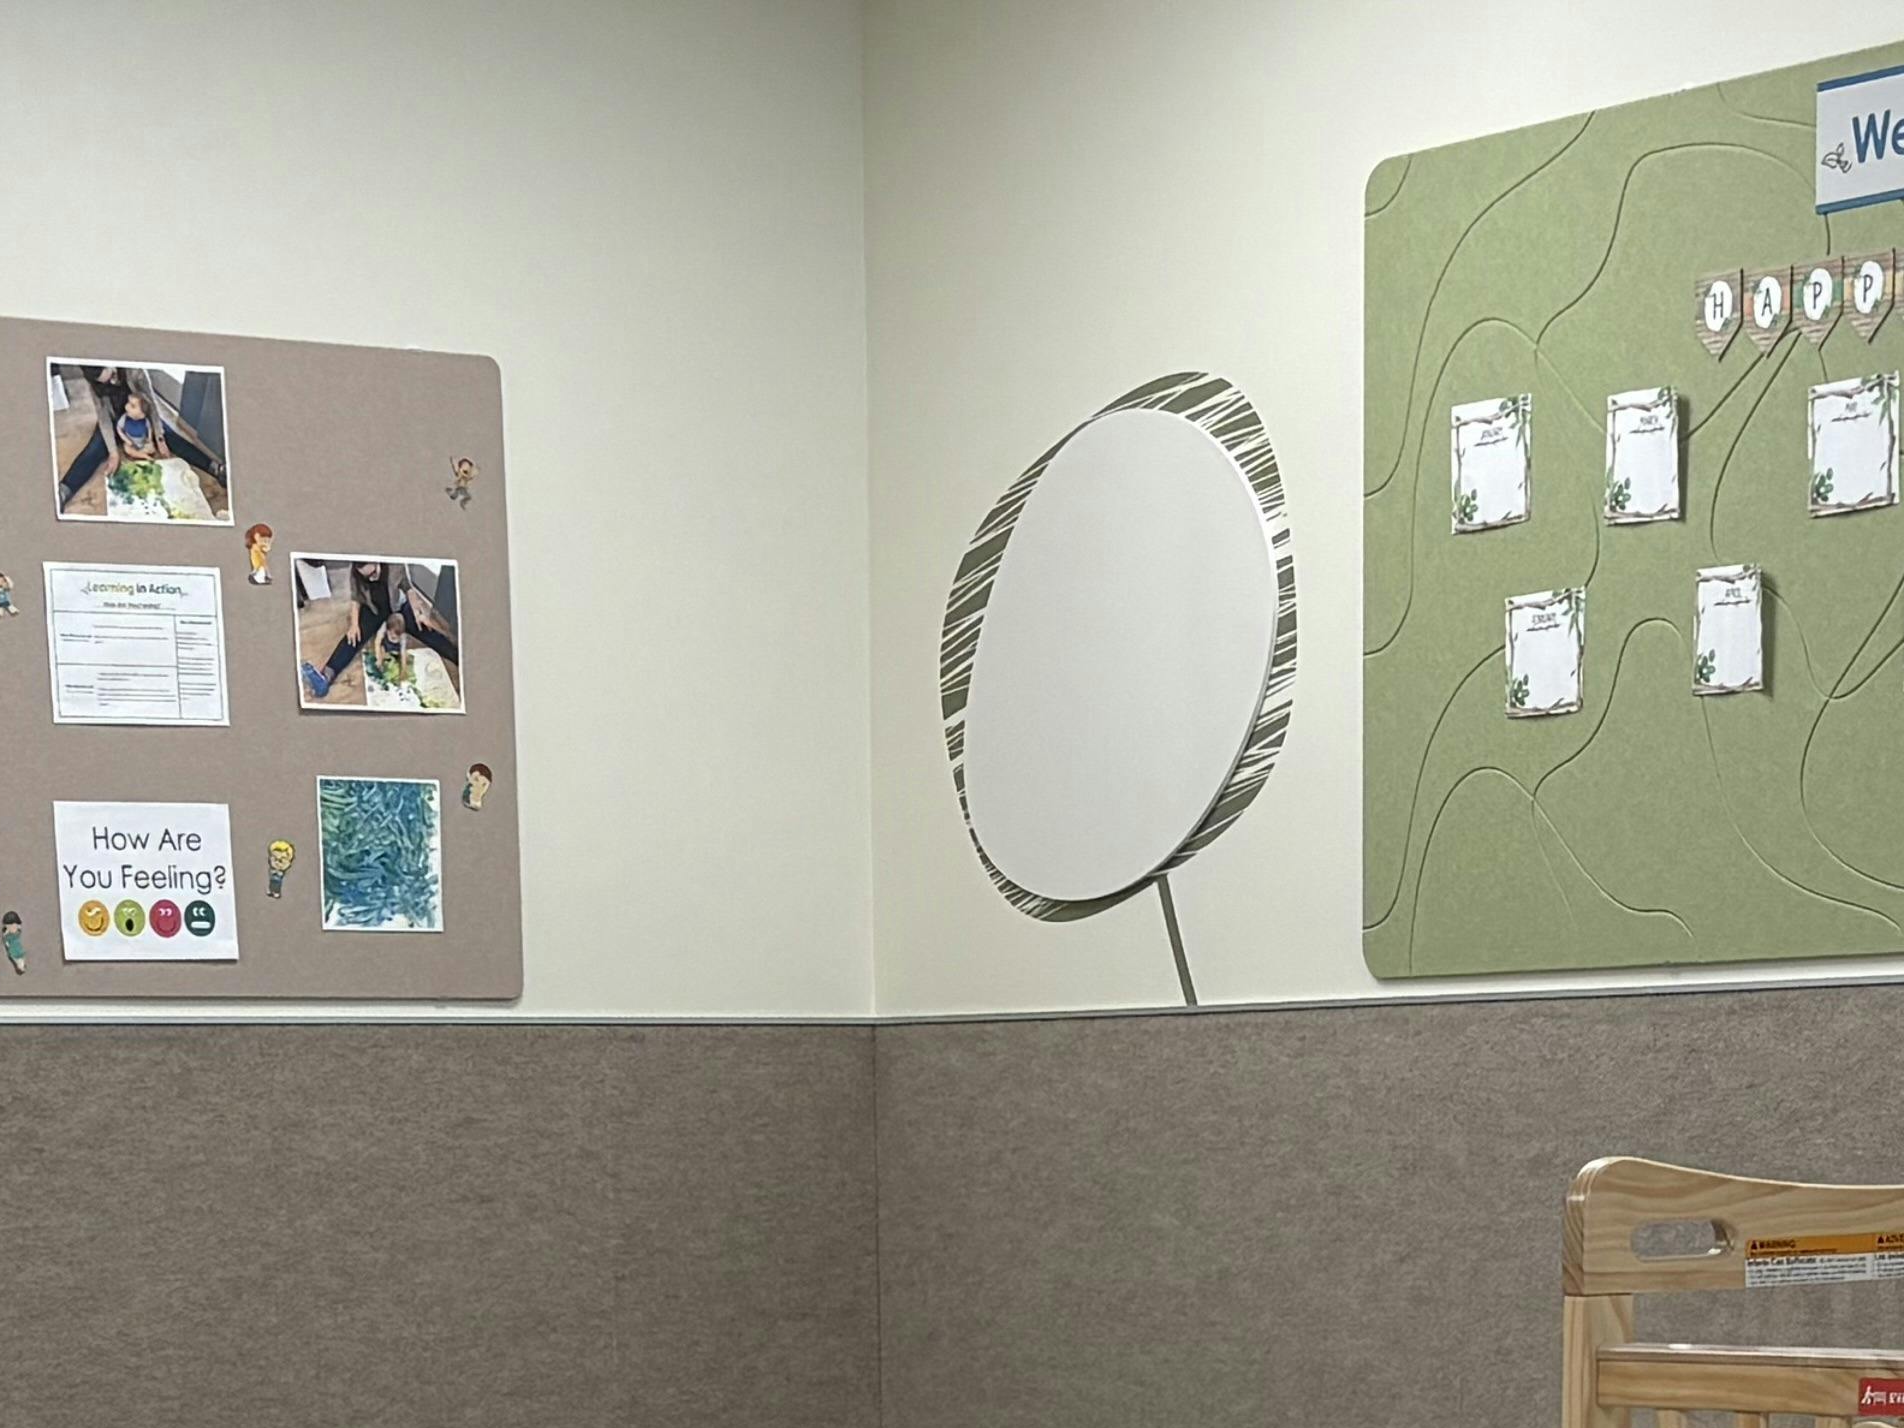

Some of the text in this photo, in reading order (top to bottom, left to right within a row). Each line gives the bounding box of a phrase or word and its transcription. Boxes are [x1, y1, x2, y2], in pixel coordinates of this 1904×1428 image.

[85, 581, 135, 596] Learning
[149, 583, 183, 595] Action
[92, 826, 202, 851] How Are
[63, 864, 226, 895] You Feeling?
